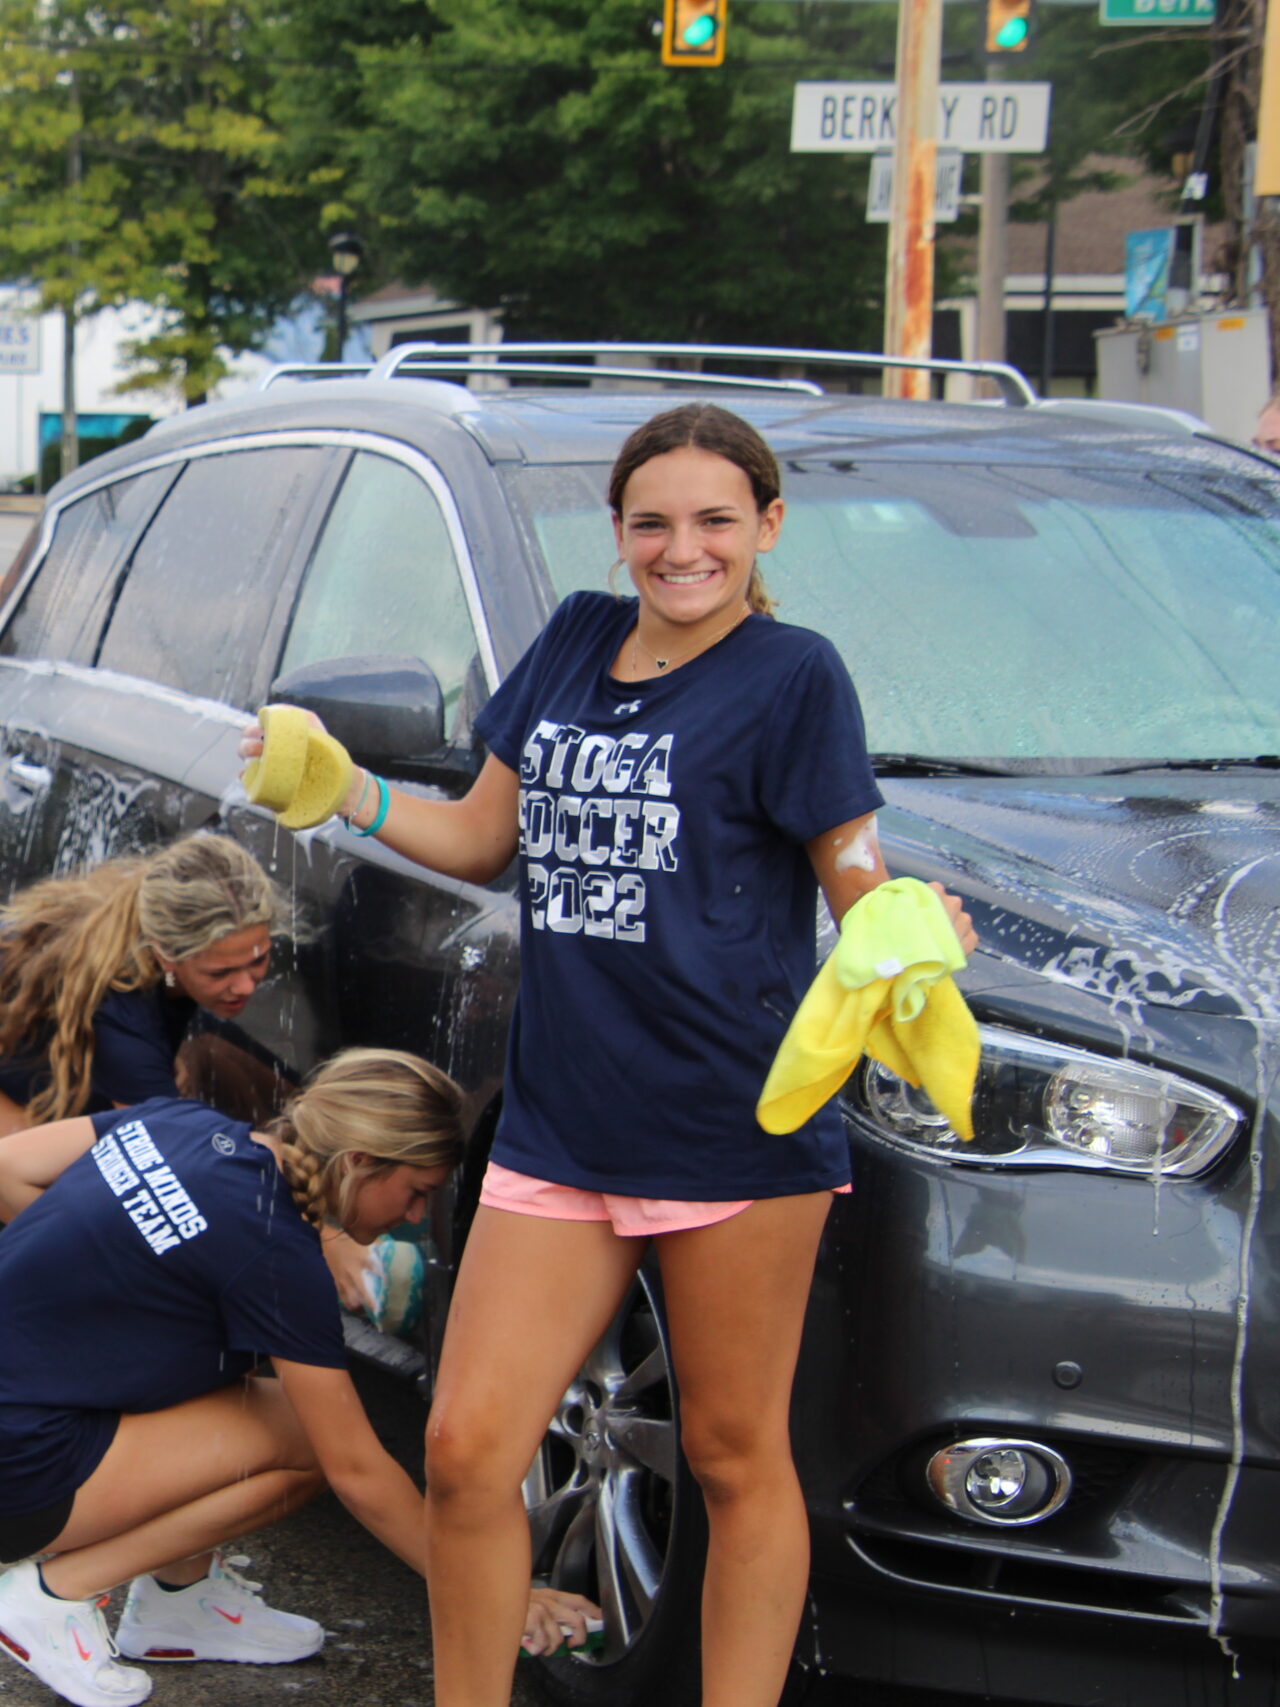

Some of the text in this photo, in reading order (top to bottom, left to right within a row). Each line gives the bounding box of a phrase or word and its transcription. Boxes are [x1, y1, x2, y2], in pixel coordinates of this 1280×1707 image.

[819, 95, 1019, 140] BERKY RD
[519, 719, 674, 797] STOGA
[91, 1133, 181, 1256] STRONGER TEAM
[116, 1119, 208, 1240] STRONG MINDS
